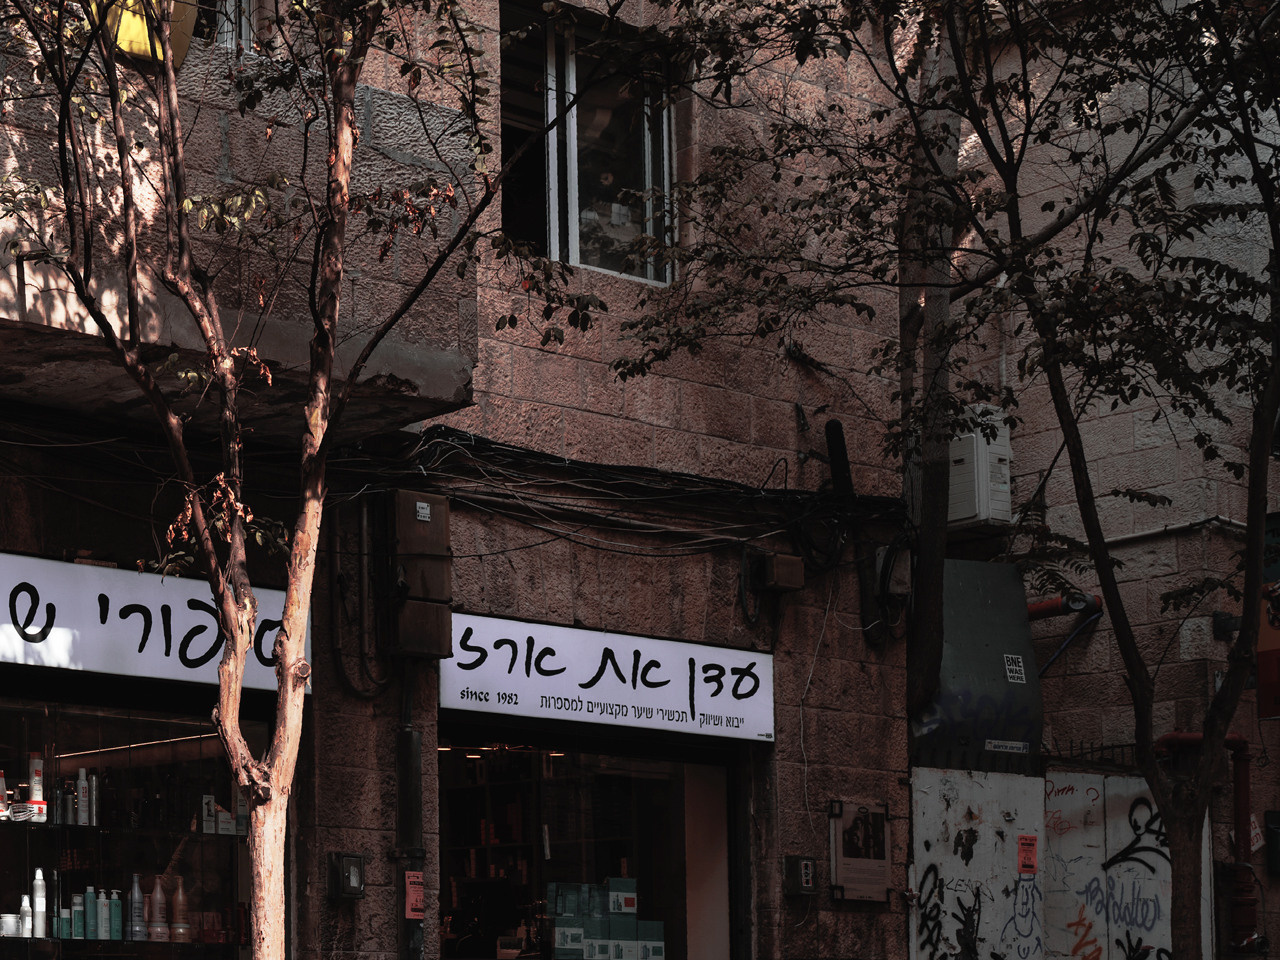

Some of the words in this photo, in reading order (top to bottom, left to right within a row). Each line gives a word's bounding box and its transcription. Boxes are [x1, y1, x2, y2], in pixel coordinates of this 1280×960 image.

[456, 626, 568, 678] ארז
[1005, 655, 1023, 668] BNE
[577, 646, 672, 690] את
[1007, 667, 1024, 676] WAS
[1008, 674, 1025, 682] HERE
[459, 686, 490, 703] since
[496, 690, 520, 707] 1982
[687, 657, 761, 722] עדן
[539, 693, 584, 714] למספרות
[586, 700, 630, 719] מקצועיים
[631, 704, 655, 720] שיער
[655, 707, 688, 724] תכשירי
